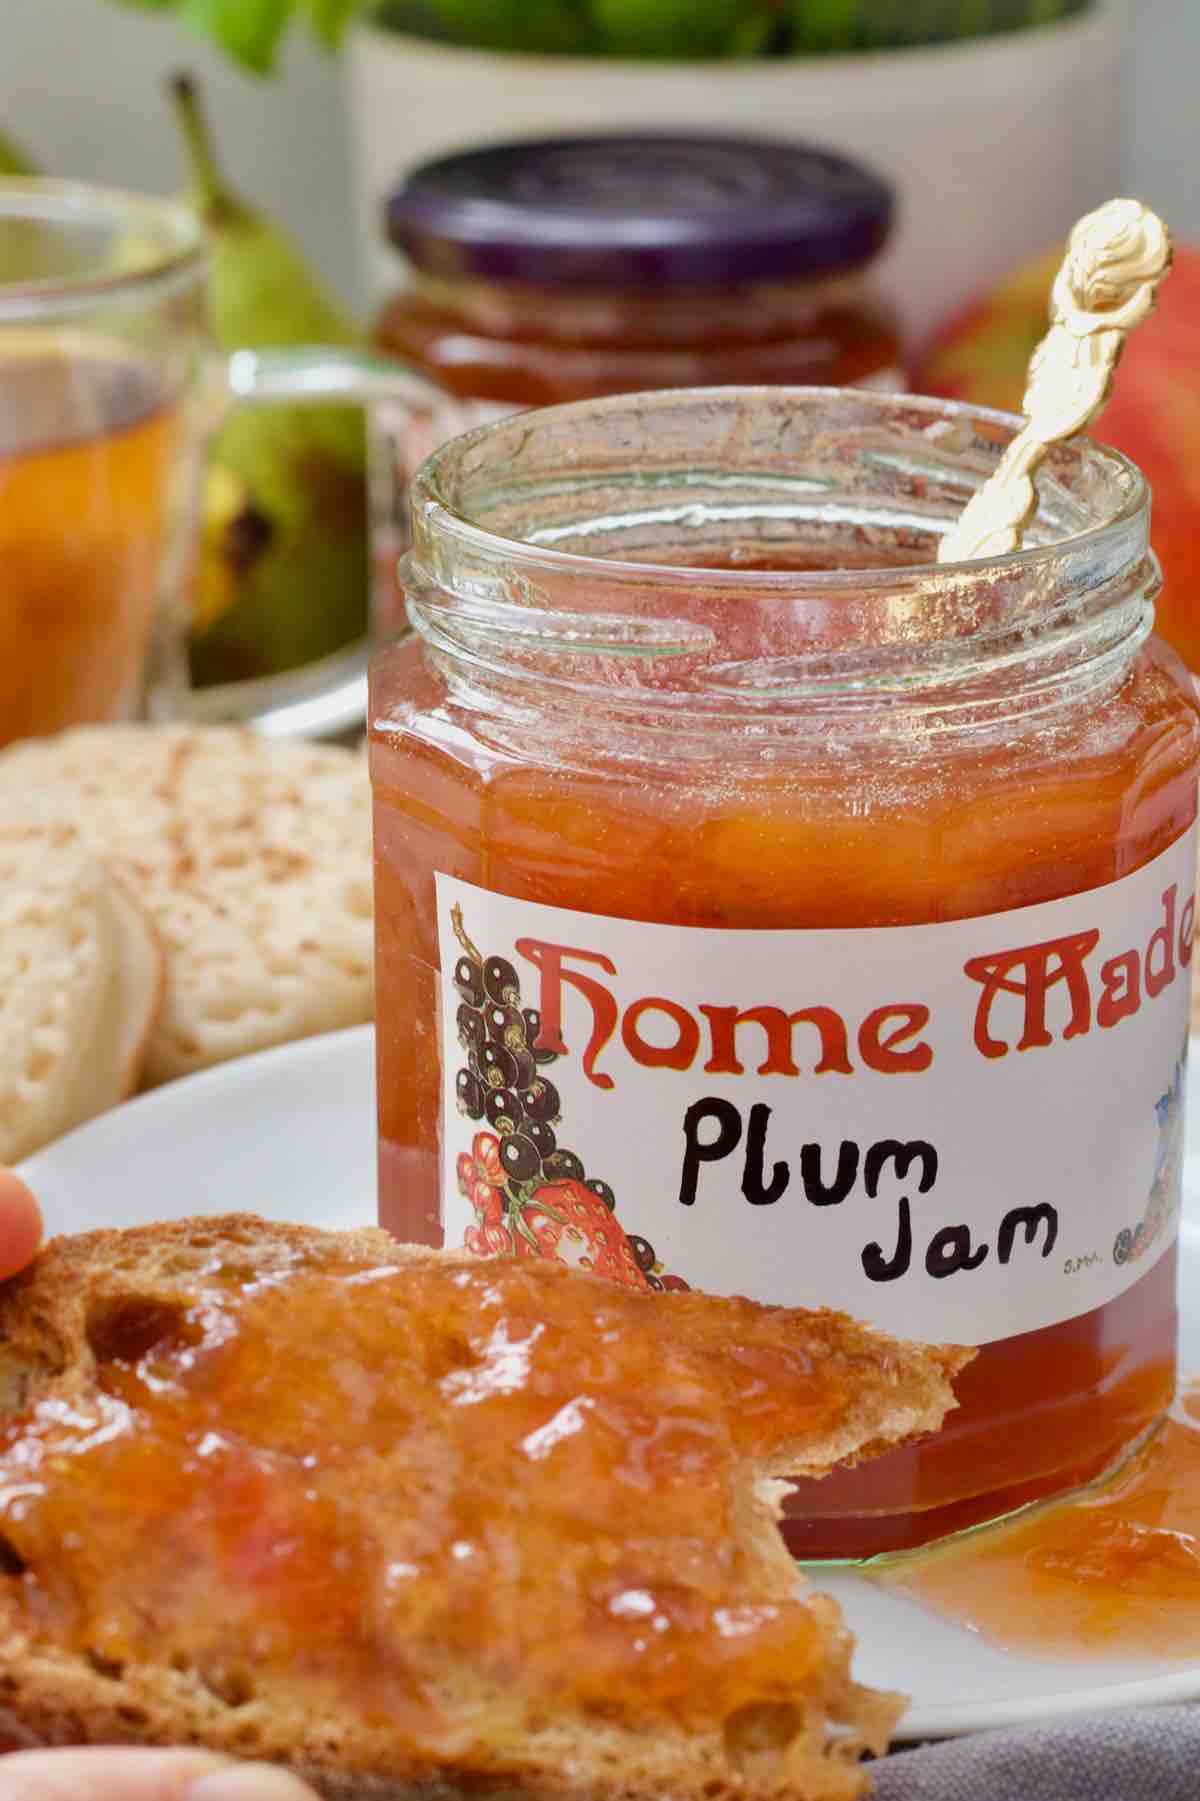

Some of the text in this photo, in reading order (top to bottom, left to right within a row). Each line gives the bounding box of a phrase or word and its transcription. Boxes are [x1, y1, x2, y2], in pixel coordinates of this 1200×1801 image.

[513, 883, 1196, 1089] Home Made
[679, 1097, 939, 1206] Plum
[861, 1196, 1058, 1281] Jam
